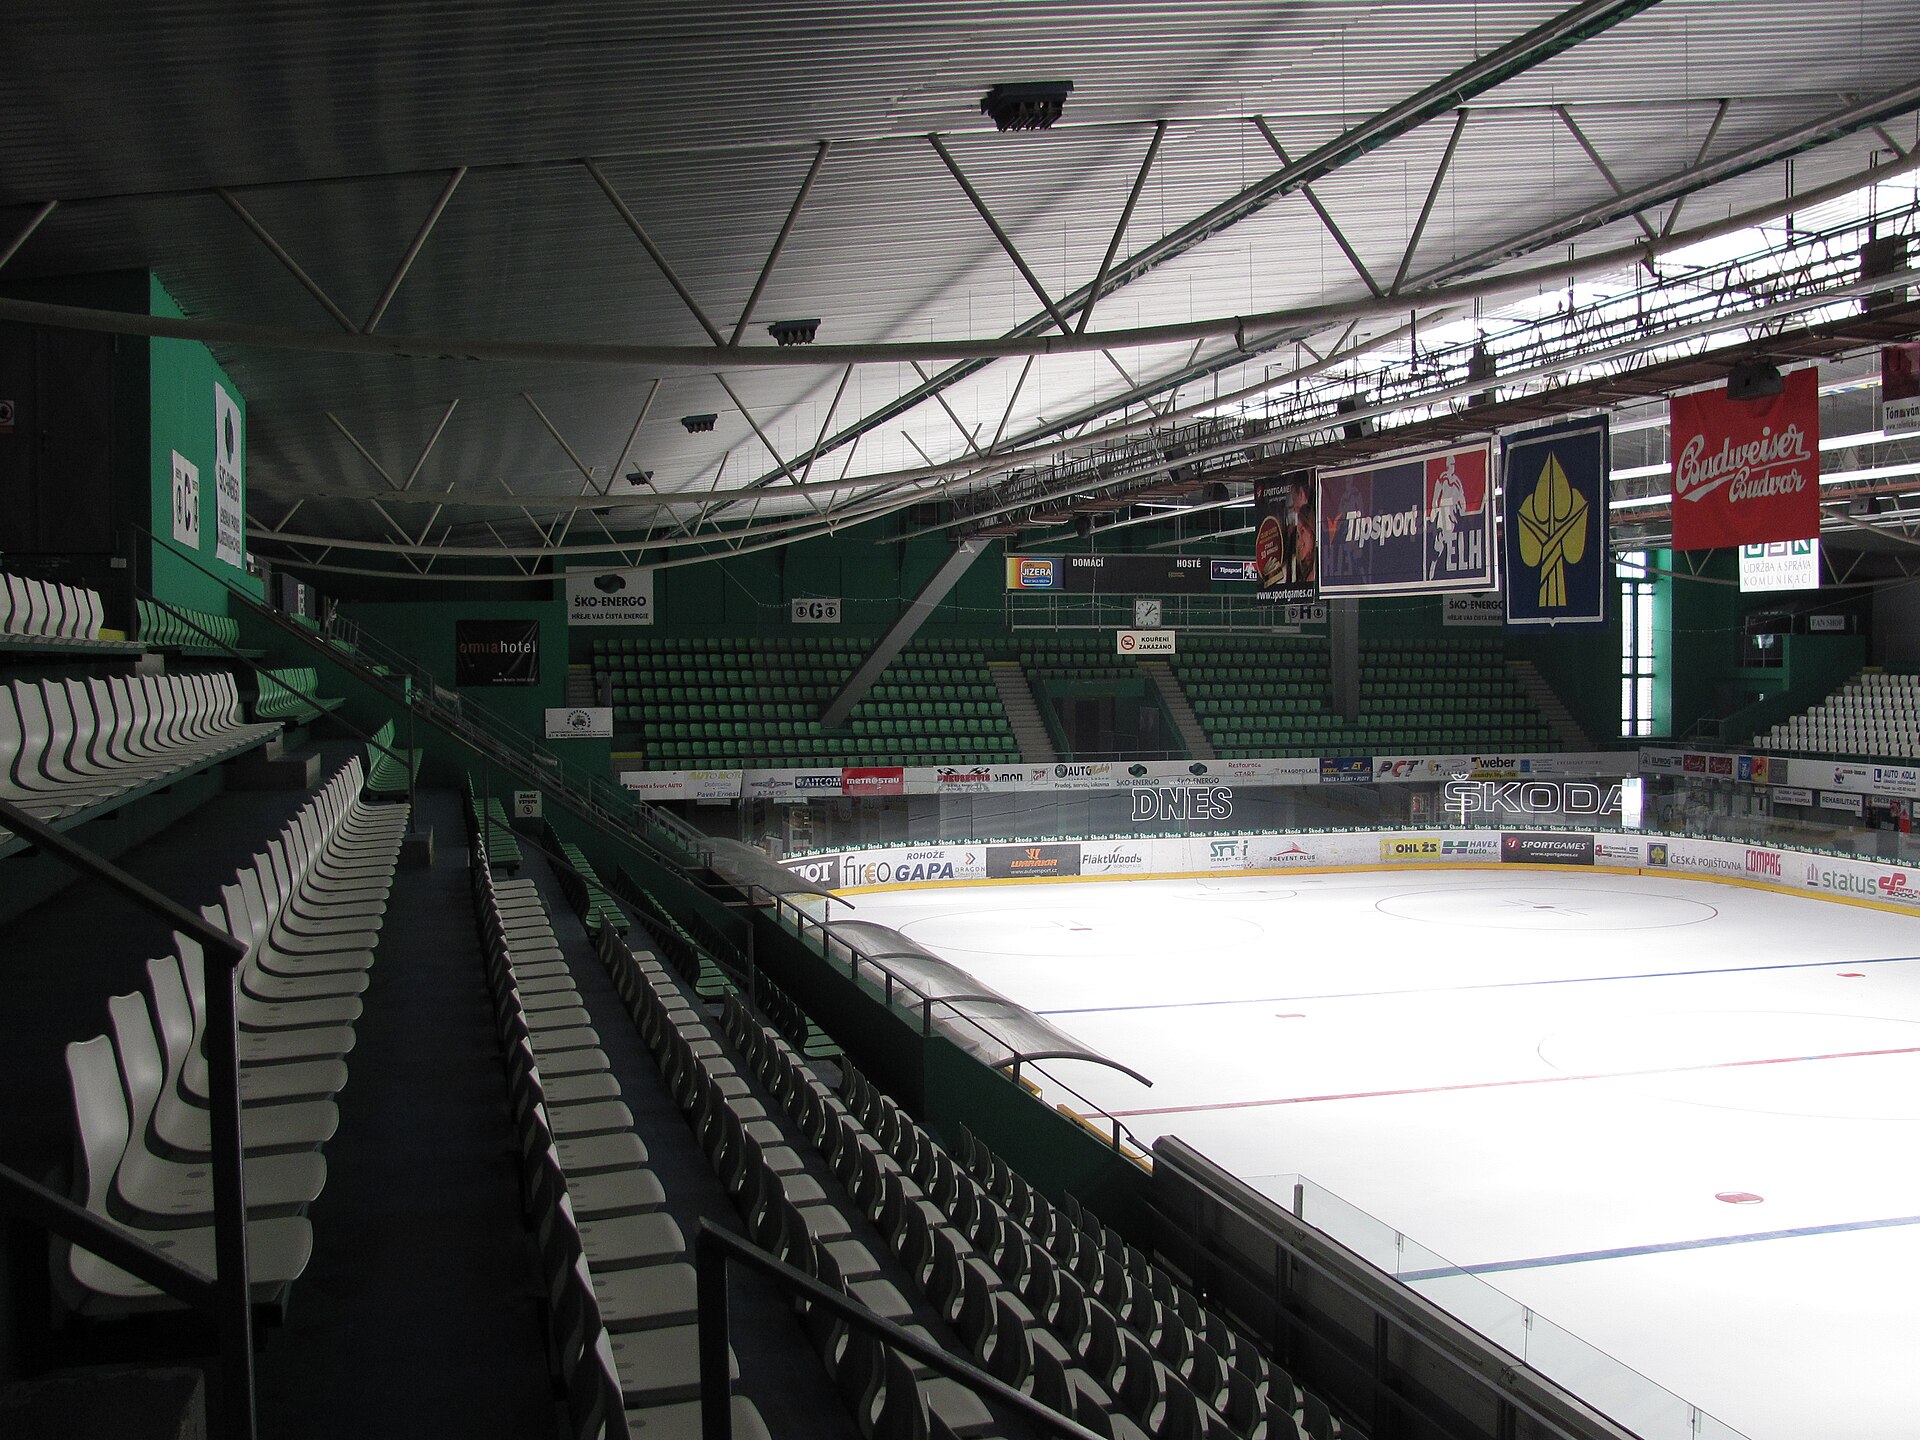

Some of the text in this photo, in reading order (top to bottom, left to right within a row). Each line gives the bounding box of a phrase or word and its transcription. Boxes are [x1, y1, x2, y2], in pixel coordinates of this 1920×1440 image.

[1676, 424, 1809, 493] Budweiser
[1729, 469, 1806, 503] Budvar
[1345, 504, 1418, 548] Tipsport
[1445, 529, 1482, 572] ELH
[1072, 557, 1104, 567] DOMÁCÍ
[1176, 558, 1201, 568] HOSTÉ
[1743, 558, 1812, 574] ÚDRŽBA A SPRÁVA
[1022, 568, 1052, 576] JIZERA
[1219, 566, 1242, 574] Tipsport
[1743, 571, 1811, 586] KOMUNIKACÍ
[574, 595, 647, 607] ŠKO-ENERGO
[571, 612, 591, 620] HŘEJE
[624, 612, 649, 620] ENERGIE
[809, 603, 823, 619] G
[1300, 605, 1312, 619] H
[1480, 756, 1516, 768] weber
[1068, 765, 1091, 776] AUTO
[1884, 769, 1899, 779] AUTO
[804, 778, 842, 788] AITCOM
[1444, 773, 1624, 816] ŠKODA
[1131, 787, 1233, 822] DNES
[1822, 795, 1861, 807] REHABILITACE
[1015, 835, 1032, 843] Škoda
[1401, 823, 1418, 831] Škoda
[1623, 827, 1640, 835] Škoda
[1692, 832, 1707, 840] Škoda
[1395, 841, 1437, 853] OHL ŽS
[1520, 841, 1586, 850] SPORTGAMES
[906, 849, 945, 861] ROHOŽE
[1082, 853, 1142, 865] FläktWoods
[1010, 859, 1058, 868] WARRIOR
[1670, 852, 1742, 871] ČESKÁ POJIŠŤOVNA
[1745, 849, 1781, 876] COMPAG
[894, 862, 954, 882] GAPA
[955, 865, 986, 873] DRAGON
[1821, 870, 1877, 896] status
